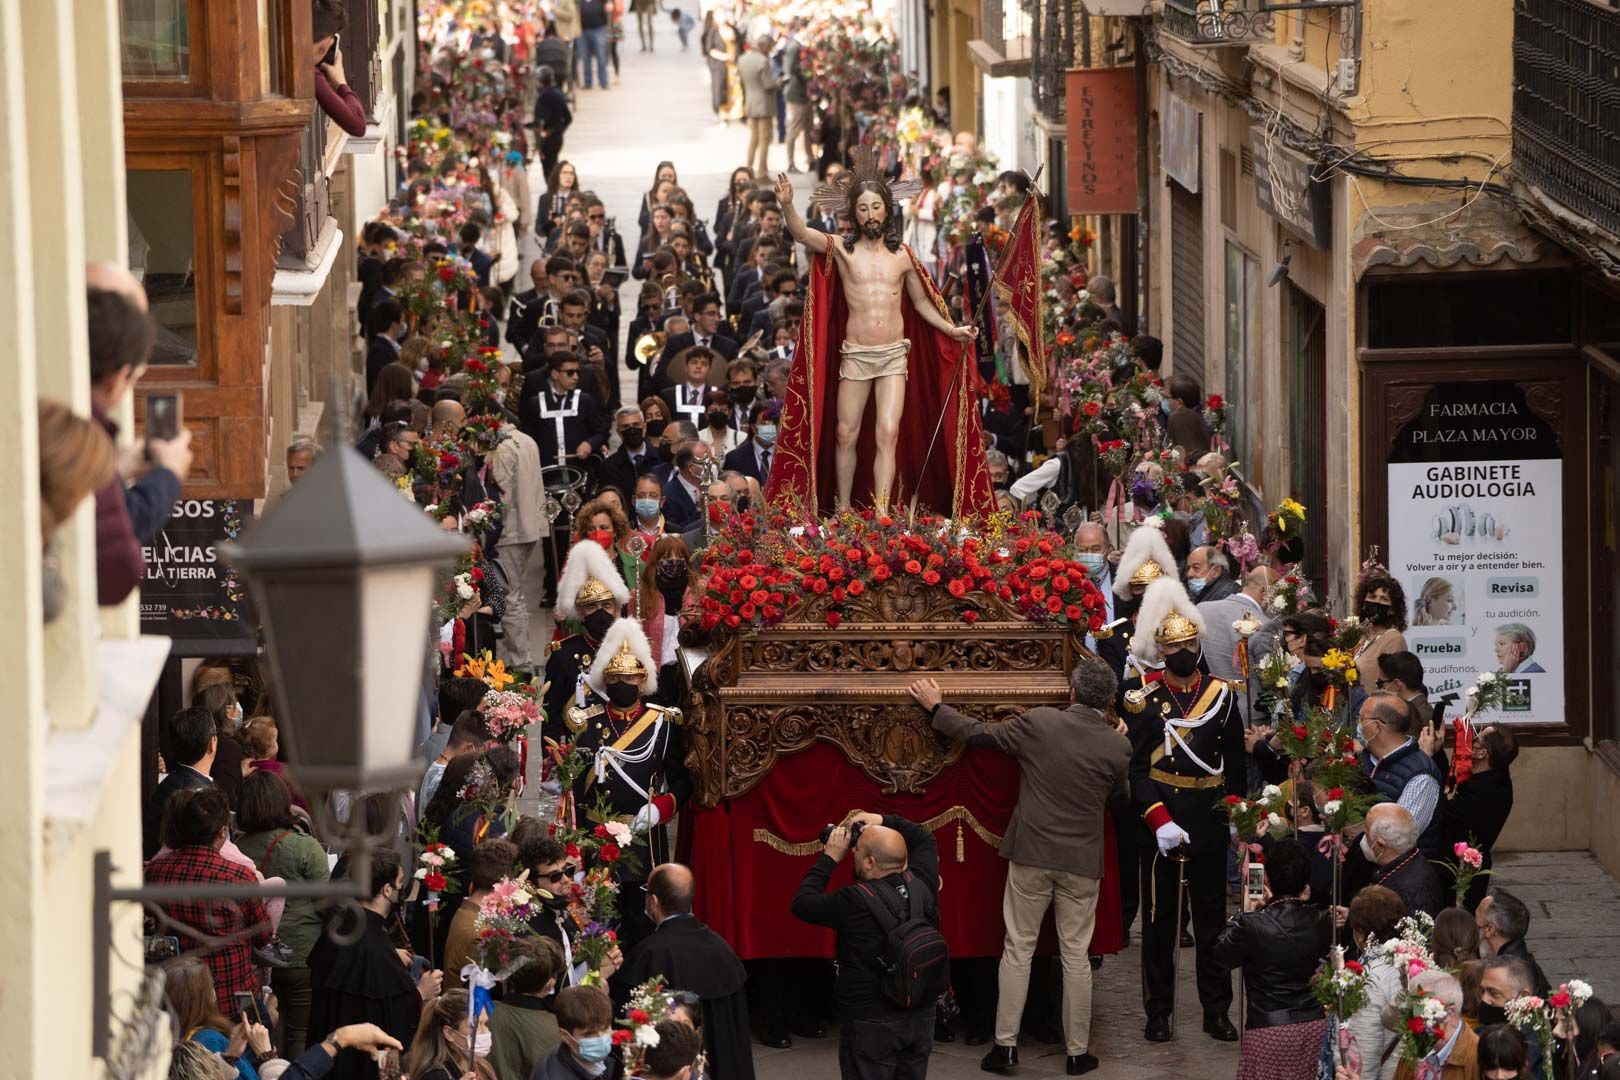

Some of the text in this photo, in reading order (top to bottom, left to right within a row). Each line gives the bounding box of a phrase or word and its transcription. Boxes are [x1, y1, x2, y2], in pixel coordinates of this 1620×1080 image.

[1081, 86, 1097, 195] ENTREVINOS
[1430, 402, 1518, 417] FARMACIA
[1412, 427, 1537, 443] PLAZA MAYOR
[1426, 465, 1521, 482] GABINETE
[1411, 481, 1536, 499] AUDIOLOGIA
[167, 500, 215, 518] SOS
[141, 546, 217, 563] ELICIAS
[1433, 552, 1518, 563] Tu mejor decisión:
[1406, 563, 1436, 572] Volver
[1461, 564, 1467, 572] y
[1477, 561, 1520, 570] entender
[1522, 560, 1545, 569] bien.
[147, 567, 165, 580] LA
[167, 567, 217, 580] TIERRA
[1491, 582, 1534, 593] Revisa
[1485, 608, 1541, 618] tu audición.
[1471, 626, 1478, 637] y
[1416, 642, 1462, 654] Prueba
[1428, 664, 1479, 674] audífonos.
[1428, 678, 1463, 695] ratis
